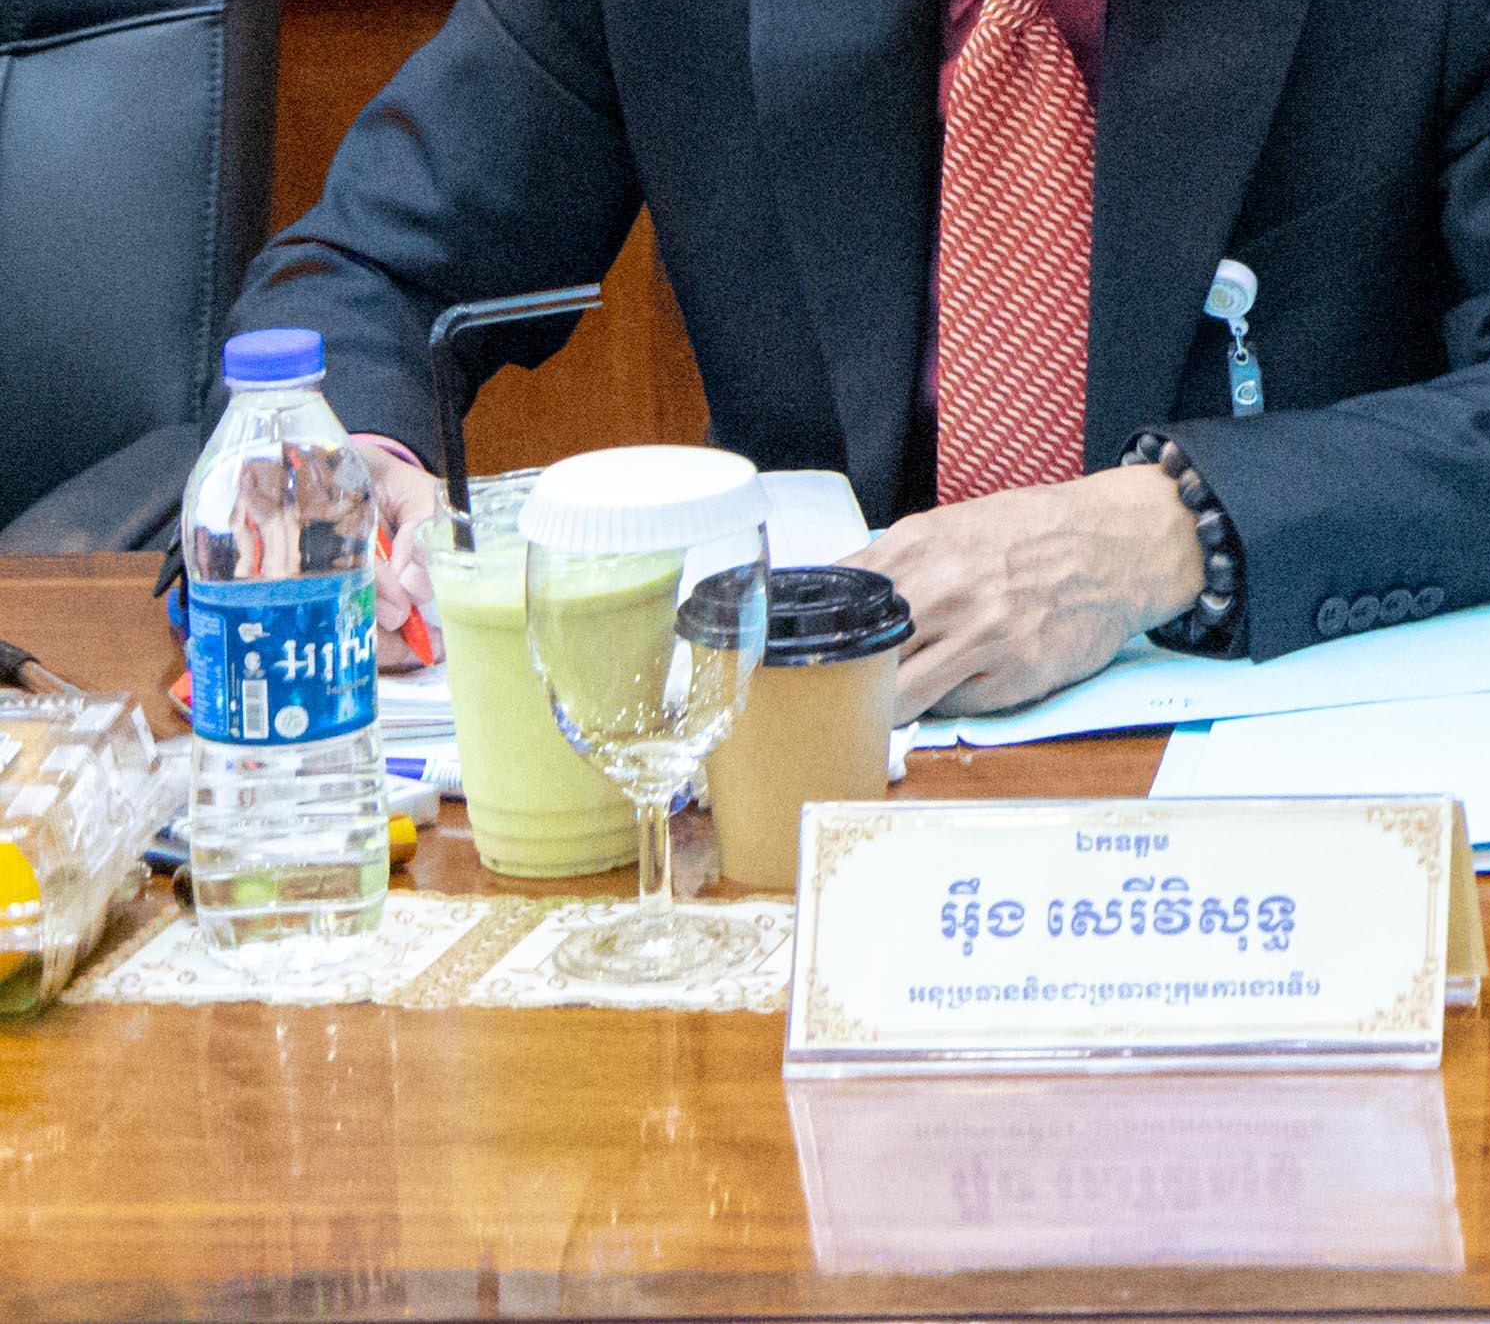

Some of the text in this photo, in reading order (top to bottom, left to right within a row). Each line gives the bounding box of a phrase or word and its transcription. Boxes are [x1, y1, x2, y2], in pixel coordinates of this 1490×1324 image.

[1076, 831, 1169, 858] ឯកឧត្តម
[1047, 874, 1297, 952] សេរីវិសុទ្ធ
